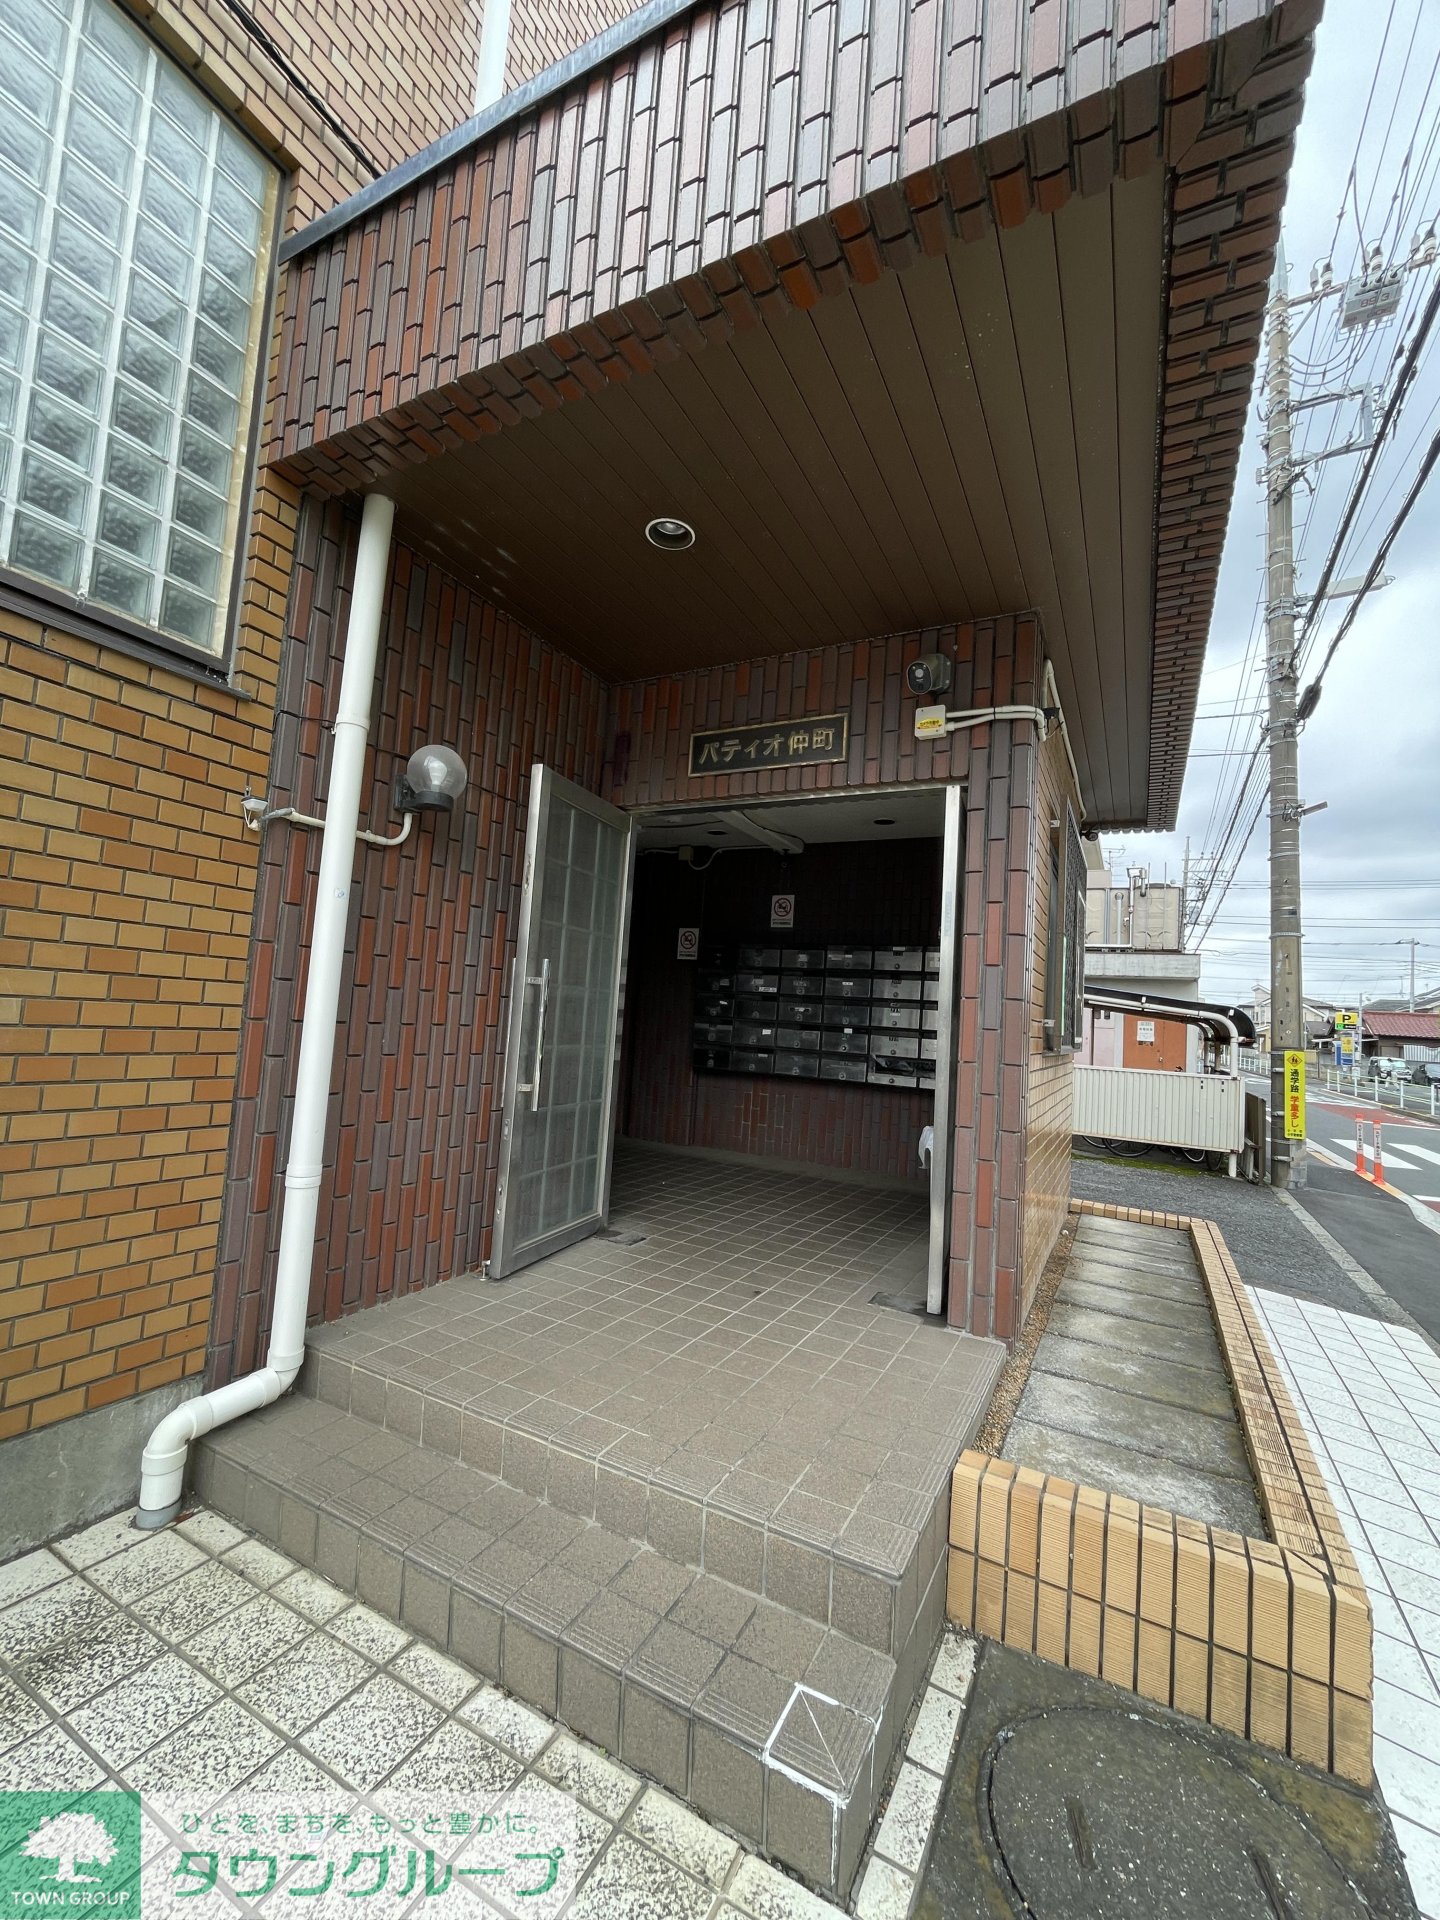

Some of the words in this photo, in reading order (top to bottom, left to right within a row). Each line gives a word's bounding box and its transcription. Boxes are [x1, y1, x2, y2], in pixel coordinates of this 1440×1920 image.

[698, 726, 835, 765] パティオ仲町
[1342, 1014, 1351, 1023] P
[1290, 1068, 1300, 1093] 通学路
[1289, 1095, 1300, 1128] 学童多し
